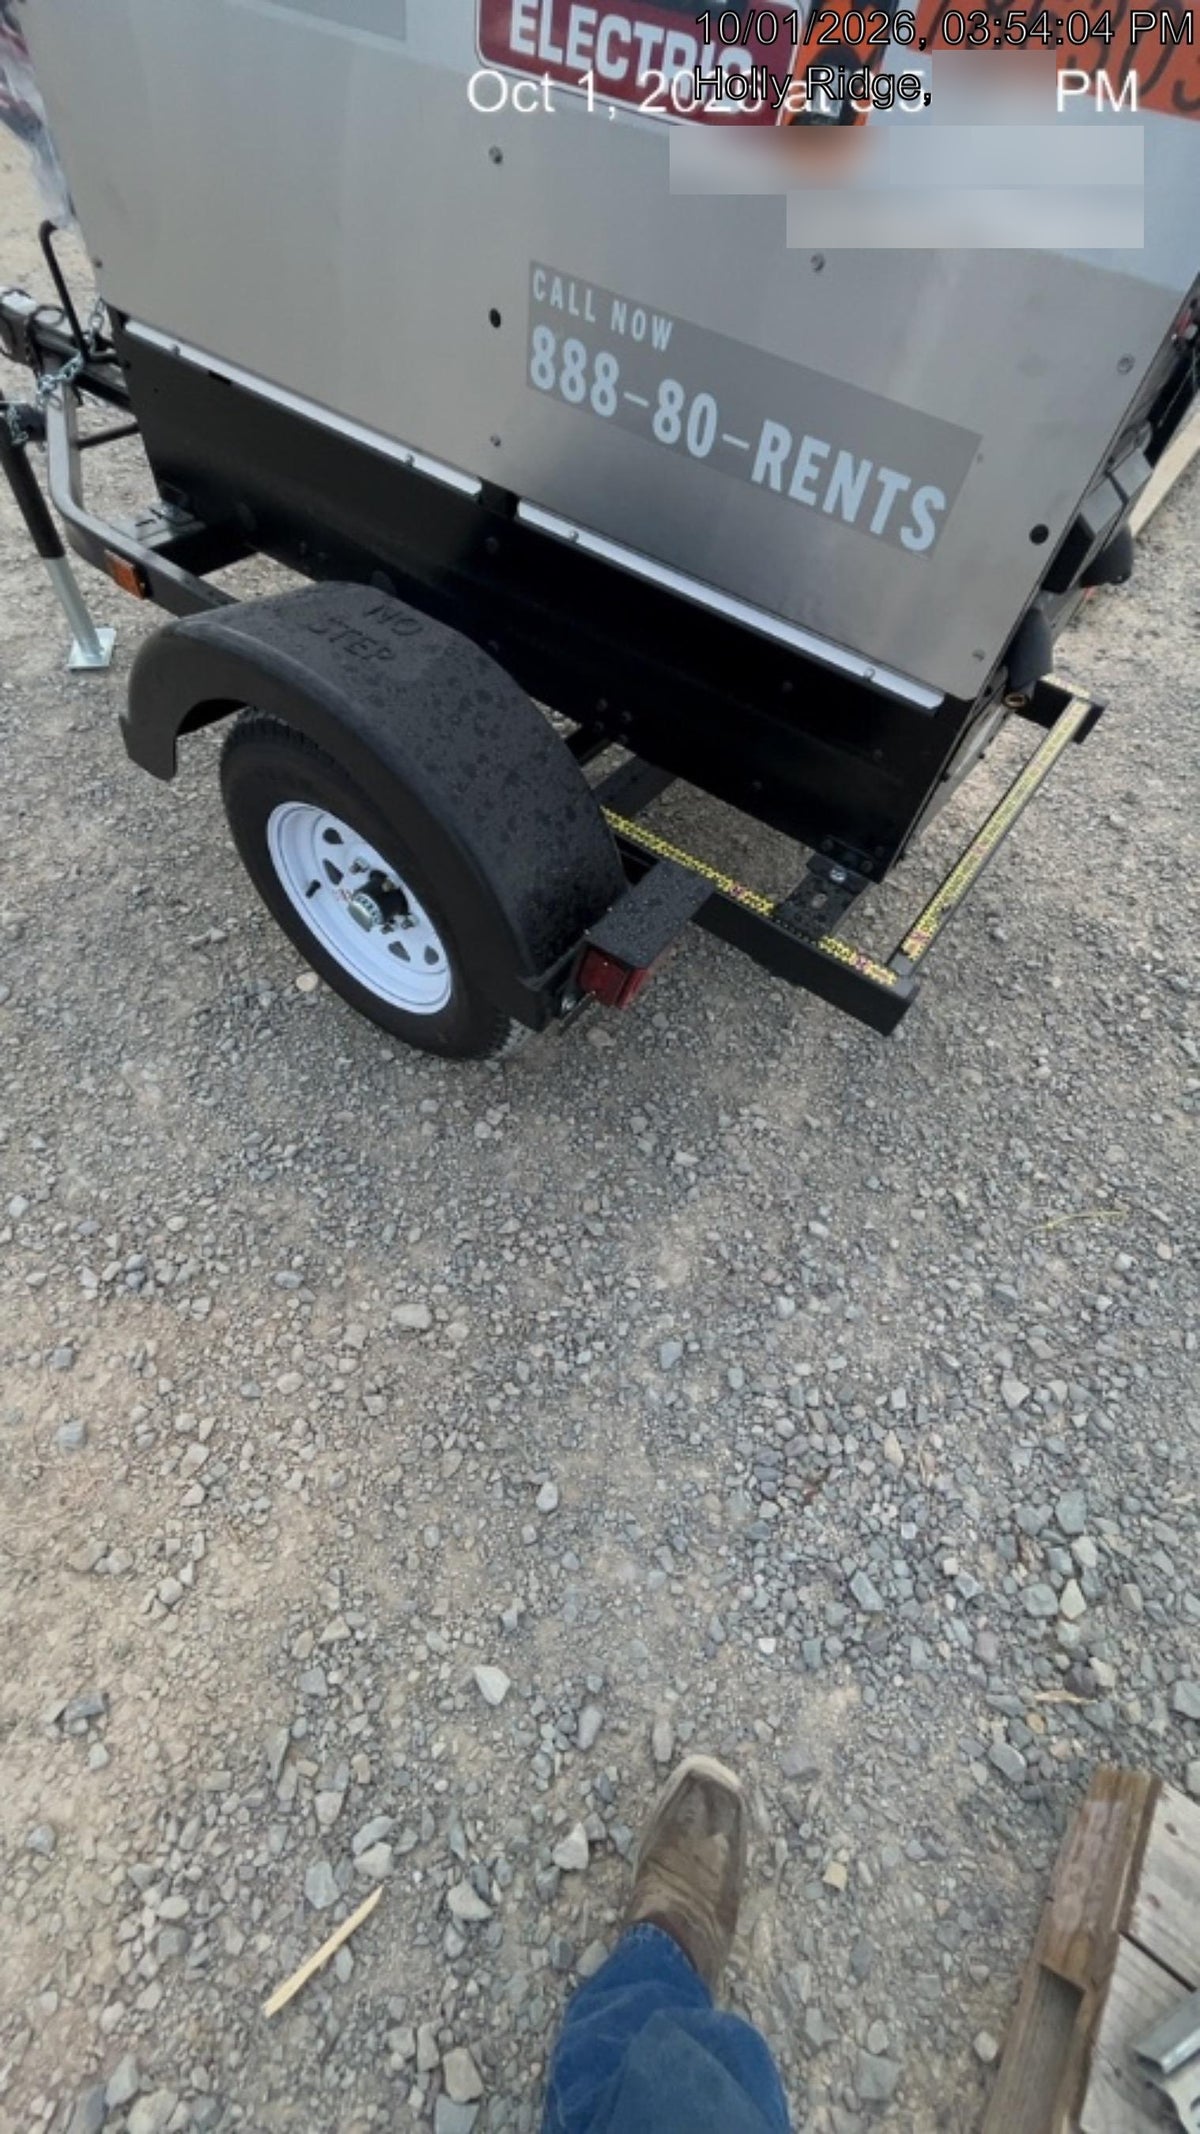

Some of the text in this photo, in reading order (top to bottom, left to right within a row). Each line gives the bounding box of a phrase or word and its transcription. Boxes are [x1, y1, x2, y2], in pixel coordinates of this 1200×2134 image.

[532, 268, 674, 352] CALL NOW
[529, 324, 947, 553] 888-80-RENTS
[306, 616, 398, 661] STEP
[362, 603, 424, 637] NO
